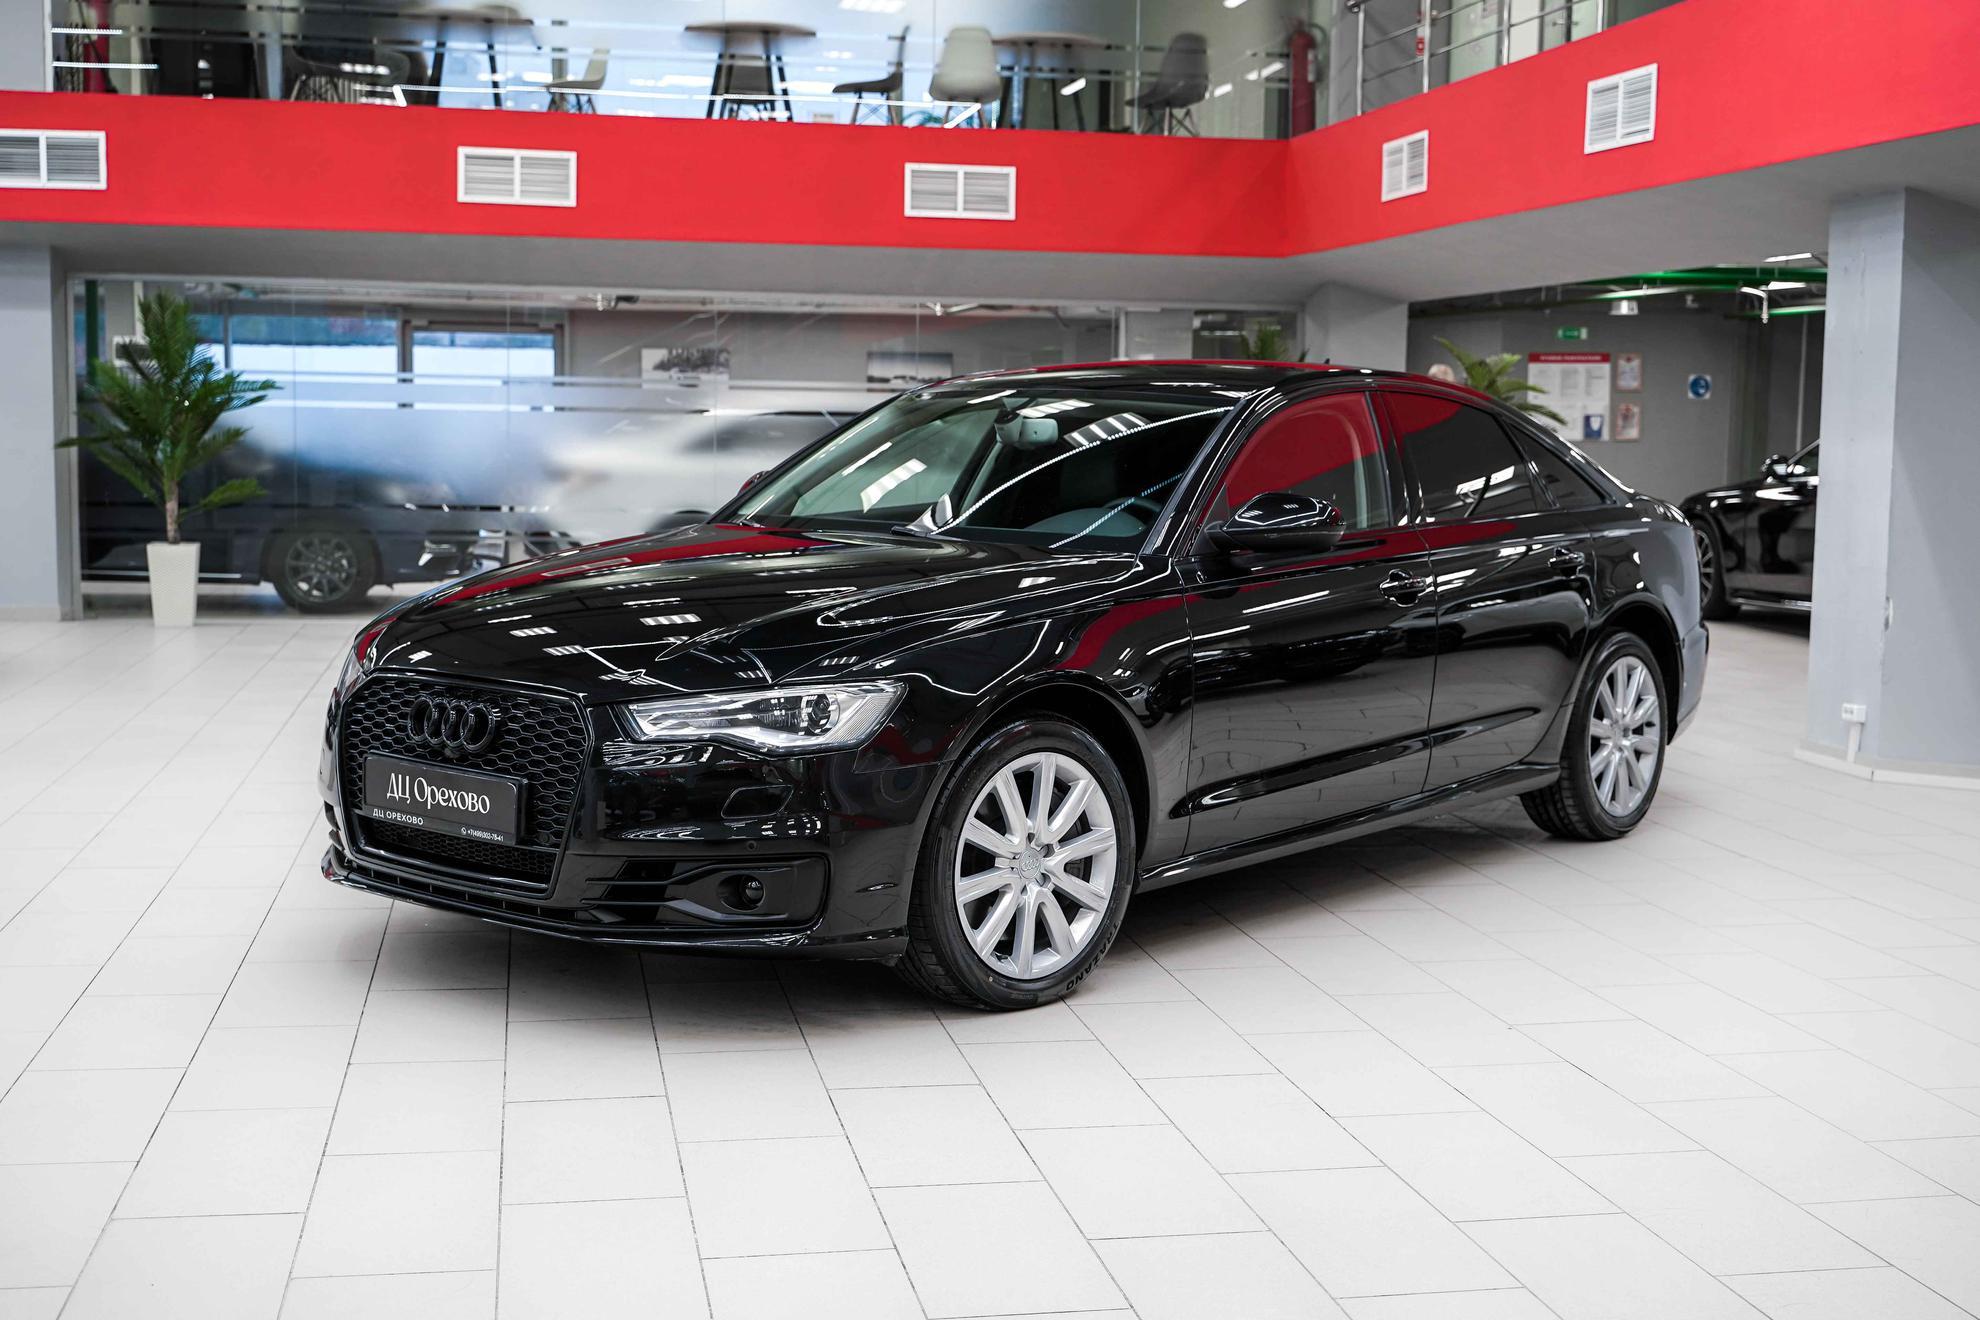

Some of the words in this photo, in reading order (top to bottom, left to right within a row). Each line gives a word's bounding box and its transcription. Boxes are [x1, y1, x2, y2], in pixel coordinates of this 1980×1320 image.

[387, 773, 410, 804] ДЦ
[414, 777, 490, 814] Орехово
[373, 808, 384, 818] ДЦ
[386, 811, 424, 826] ОРЕХОВО
[1065, 922, 1119, 991] TRAZANO
